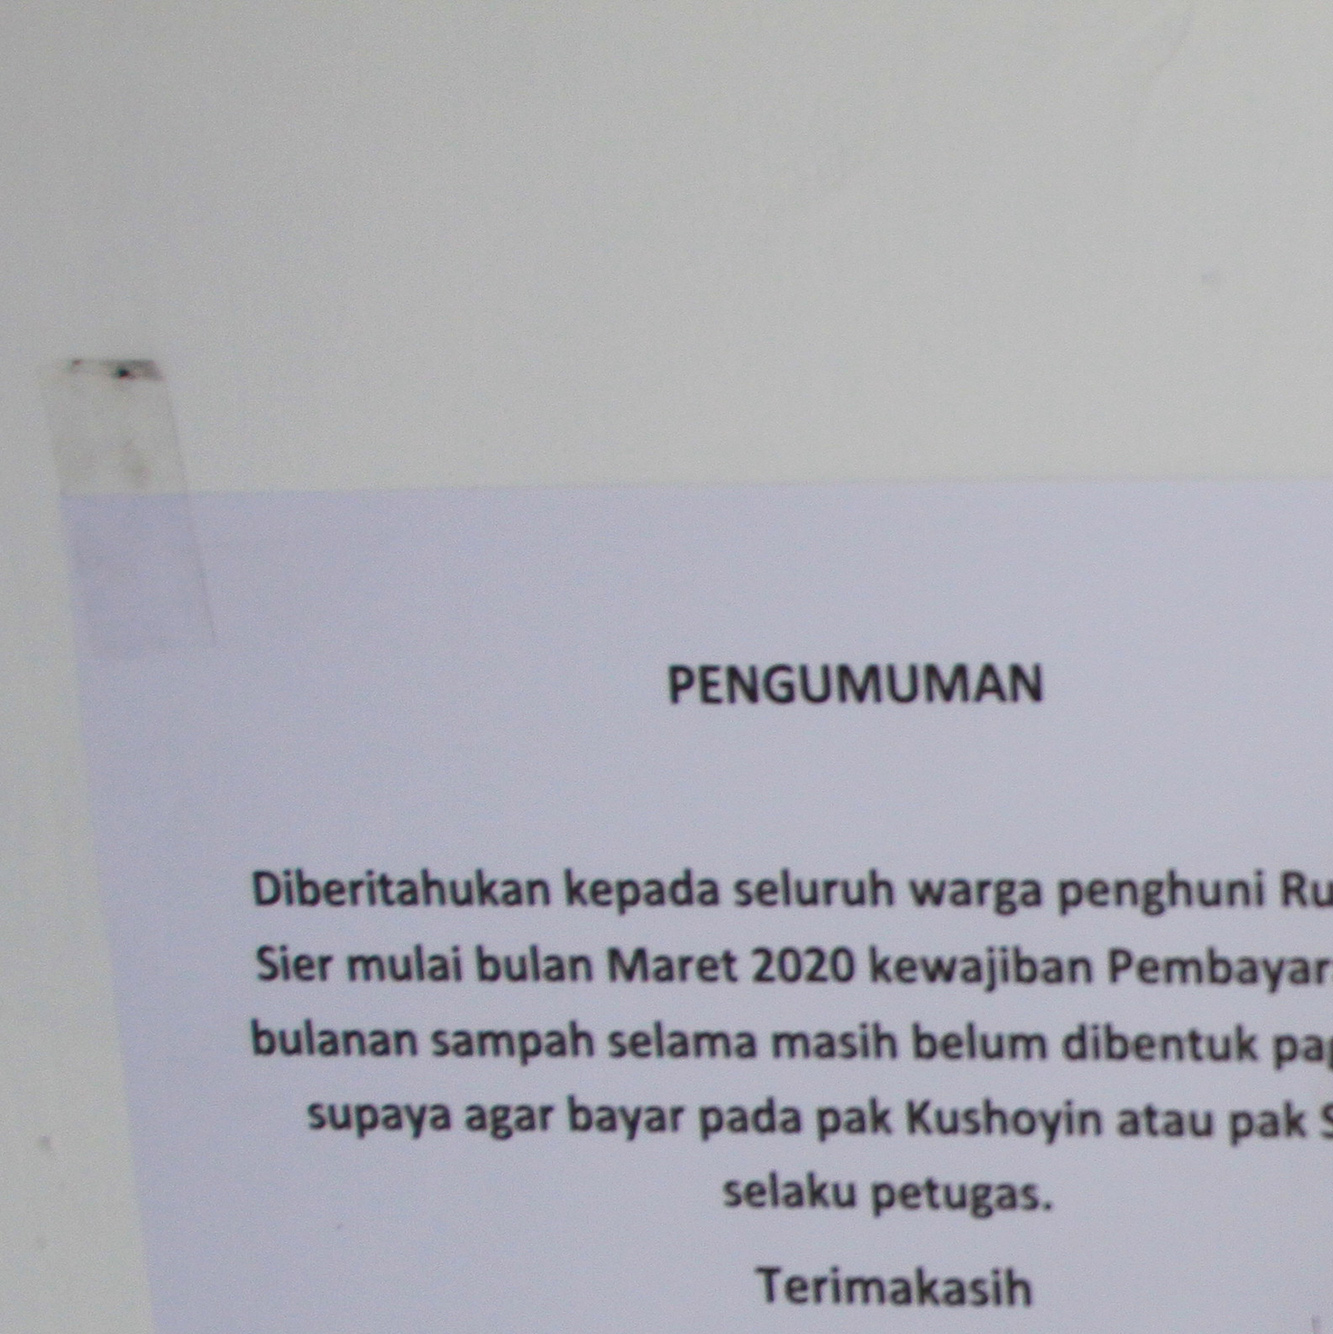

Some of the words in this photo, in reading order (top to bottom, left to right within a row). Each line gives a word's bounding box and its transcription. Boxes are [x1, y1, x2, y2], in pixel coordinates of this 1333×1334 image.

[667, 662, 1044, 706] PENGUMUMAN
[251, 867, 552, 908] Diberitahukan
[563, 867, 721, 917] kepada
[733, 867, 896, 908] seluruh
[908, 877, 1044, 918] warga
[1057, 868, 1266, 918] penghuni
[255, 944, 334, 983] Sier
[346, 943, 463, 983] mulai
[474, 943, 594, 984] bulan
[606, 946, 739, 984] Maret
[751, 945, 857, 985] 2020
[868, 944, 1094, 994] kewajiban
[250, 1017, 419, 1058] bulanan
[430, 1019, 596, 1067] sampah
[607, 1020, 758, 1060] selama
[771, 1020, 899, 1061] masih
[911, 1021, 1049, 1062] belum
[1061, 1021, 1259, 1063] dibentuk
[306, 1102, 453, 1140] supaya
[464, 1103, 556, 1142] agar
[566, 1094, 686, 1142] bayar
[698, 1095, 804, 1143] pada
[815, 1096, 893, 1143] pak
[905, 1097, 1104, 1146] Kushoyin
[1116, 1103, 1215, 1139] atau
[1228, 1100, 1308, 1148] pak
[722, 1170, 858, 1210] selaku
[870, 1176, 1053, 1221] petugas.
[753, 1265, 1033, 1308] Terimakasih
